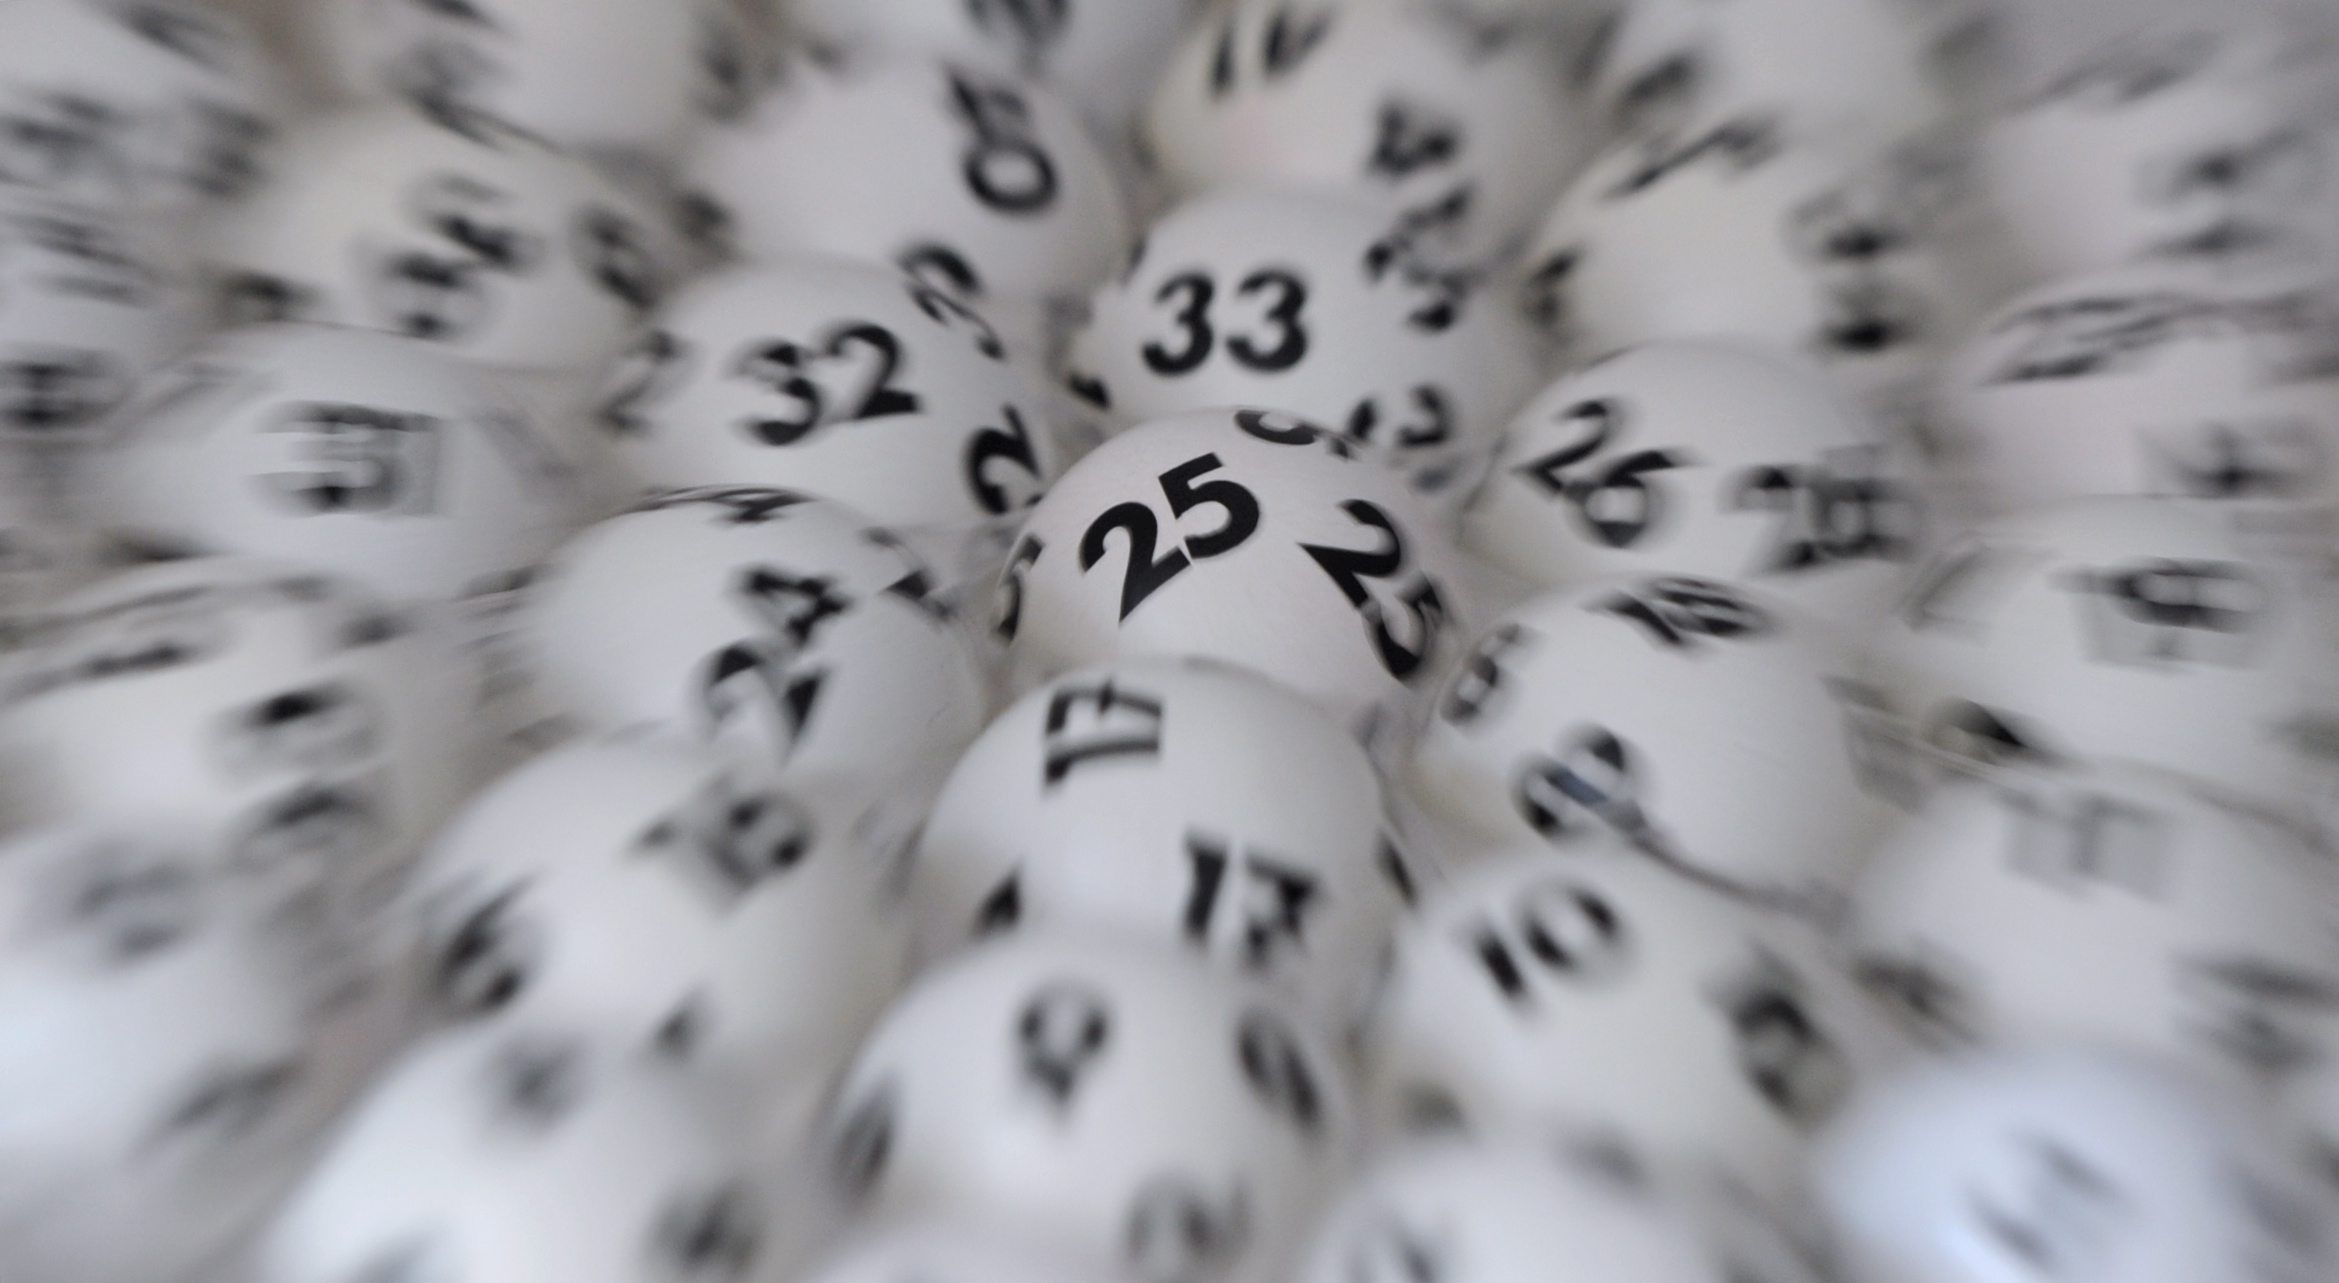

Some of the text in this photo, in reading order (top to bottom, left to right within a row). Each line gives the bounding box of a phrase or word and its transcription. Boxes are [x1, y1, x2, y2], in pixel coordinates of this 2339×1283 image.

[735, 322, 920, 447] 32
[1141, 268, 1310, 378] 33
[1078, 451, 1260, 623] 25
[1508, 398, 1688, 550] 26
[1297, 498, 1448, 681] 25
[690, 562, 850, 775] 24
[1043, 678, 1164, 788] 17
[1473, 880, 1628, 1008] 10
